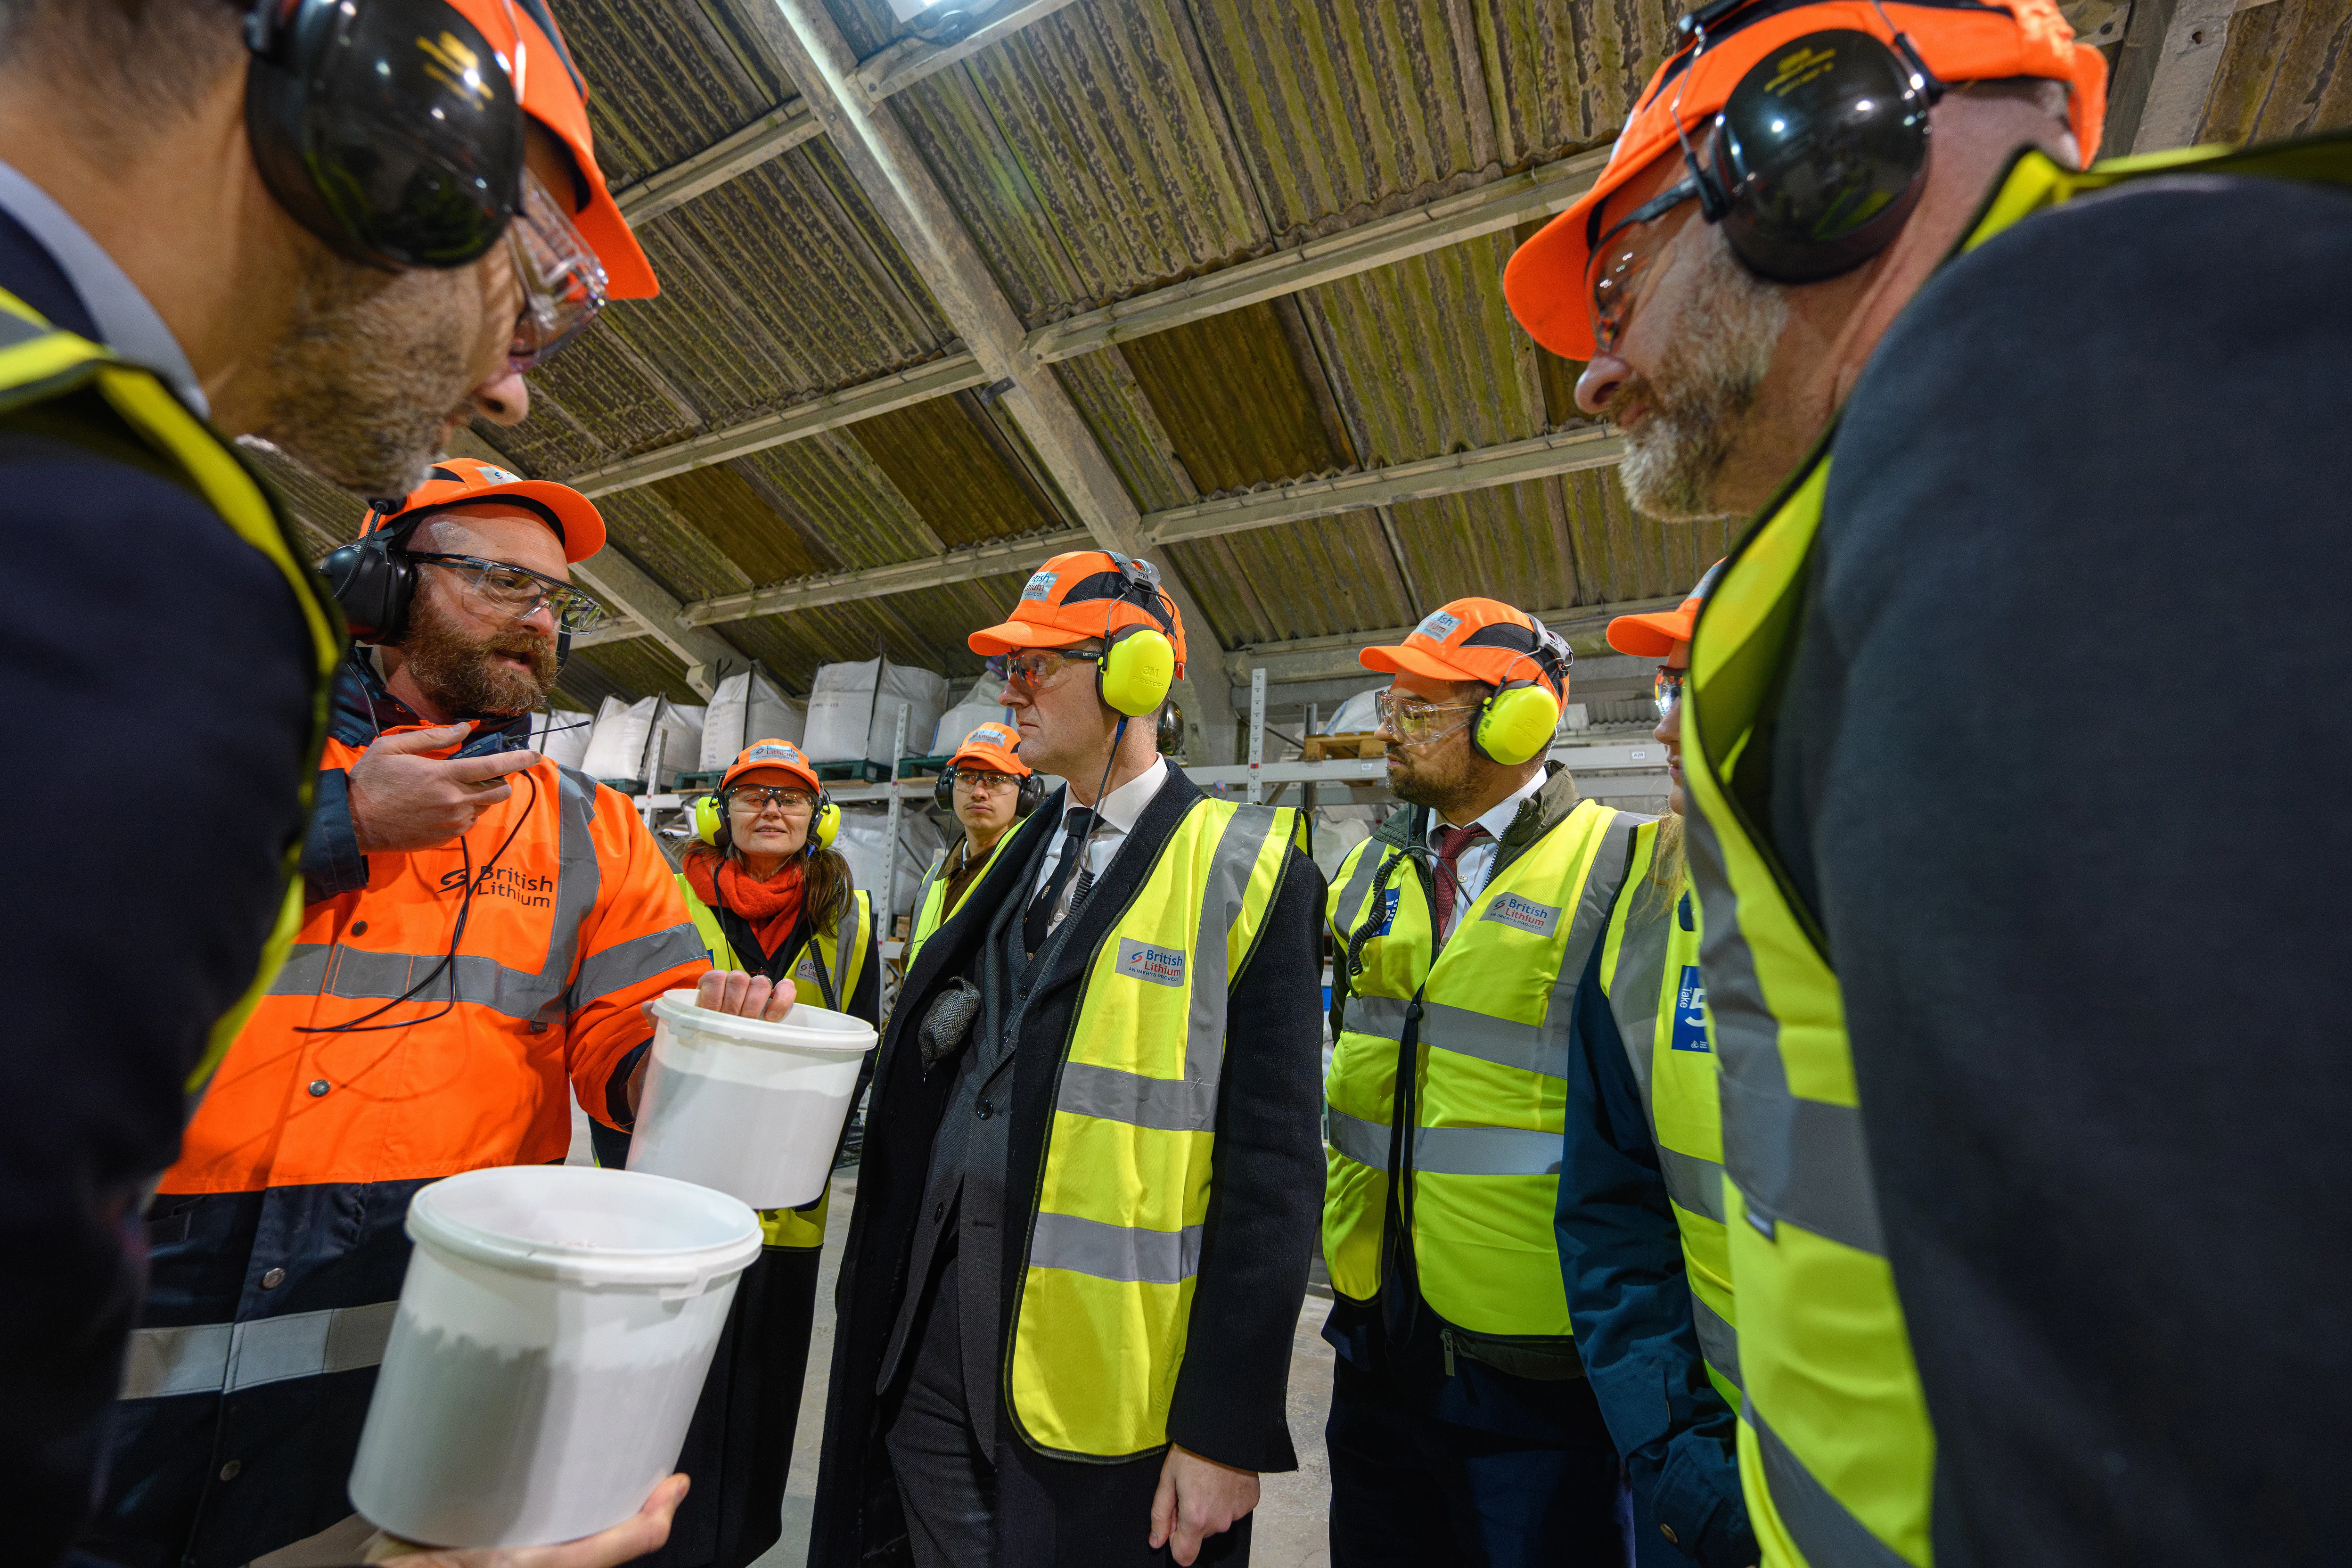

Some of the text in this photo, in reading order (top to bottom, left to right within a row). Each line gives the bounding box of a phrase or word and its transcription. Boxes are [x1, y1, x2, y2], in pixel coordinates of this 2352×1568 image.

[1142, 665, 1159, 679] 3M
[1132, 676, 1163, 689] PELTOR
[480, 866, 553, 892] British
[478, 881, 550, 908] Lithium
[1505, 908, 1544, 926] Lithium
[1508, 898, 1548, 919] British
[1497, 914, 1516, 922] IMERYS
[1517, 920, 1542, 930] PROJECT
[1146, 950, 1183, 966] British
[1137, 969, 1156, 977] IMERYS
[1144, 961, 1180, 977] Lithium
[1680, 987, 1693, 1008] Take
[1685, 988, 1707, 1027] 5
